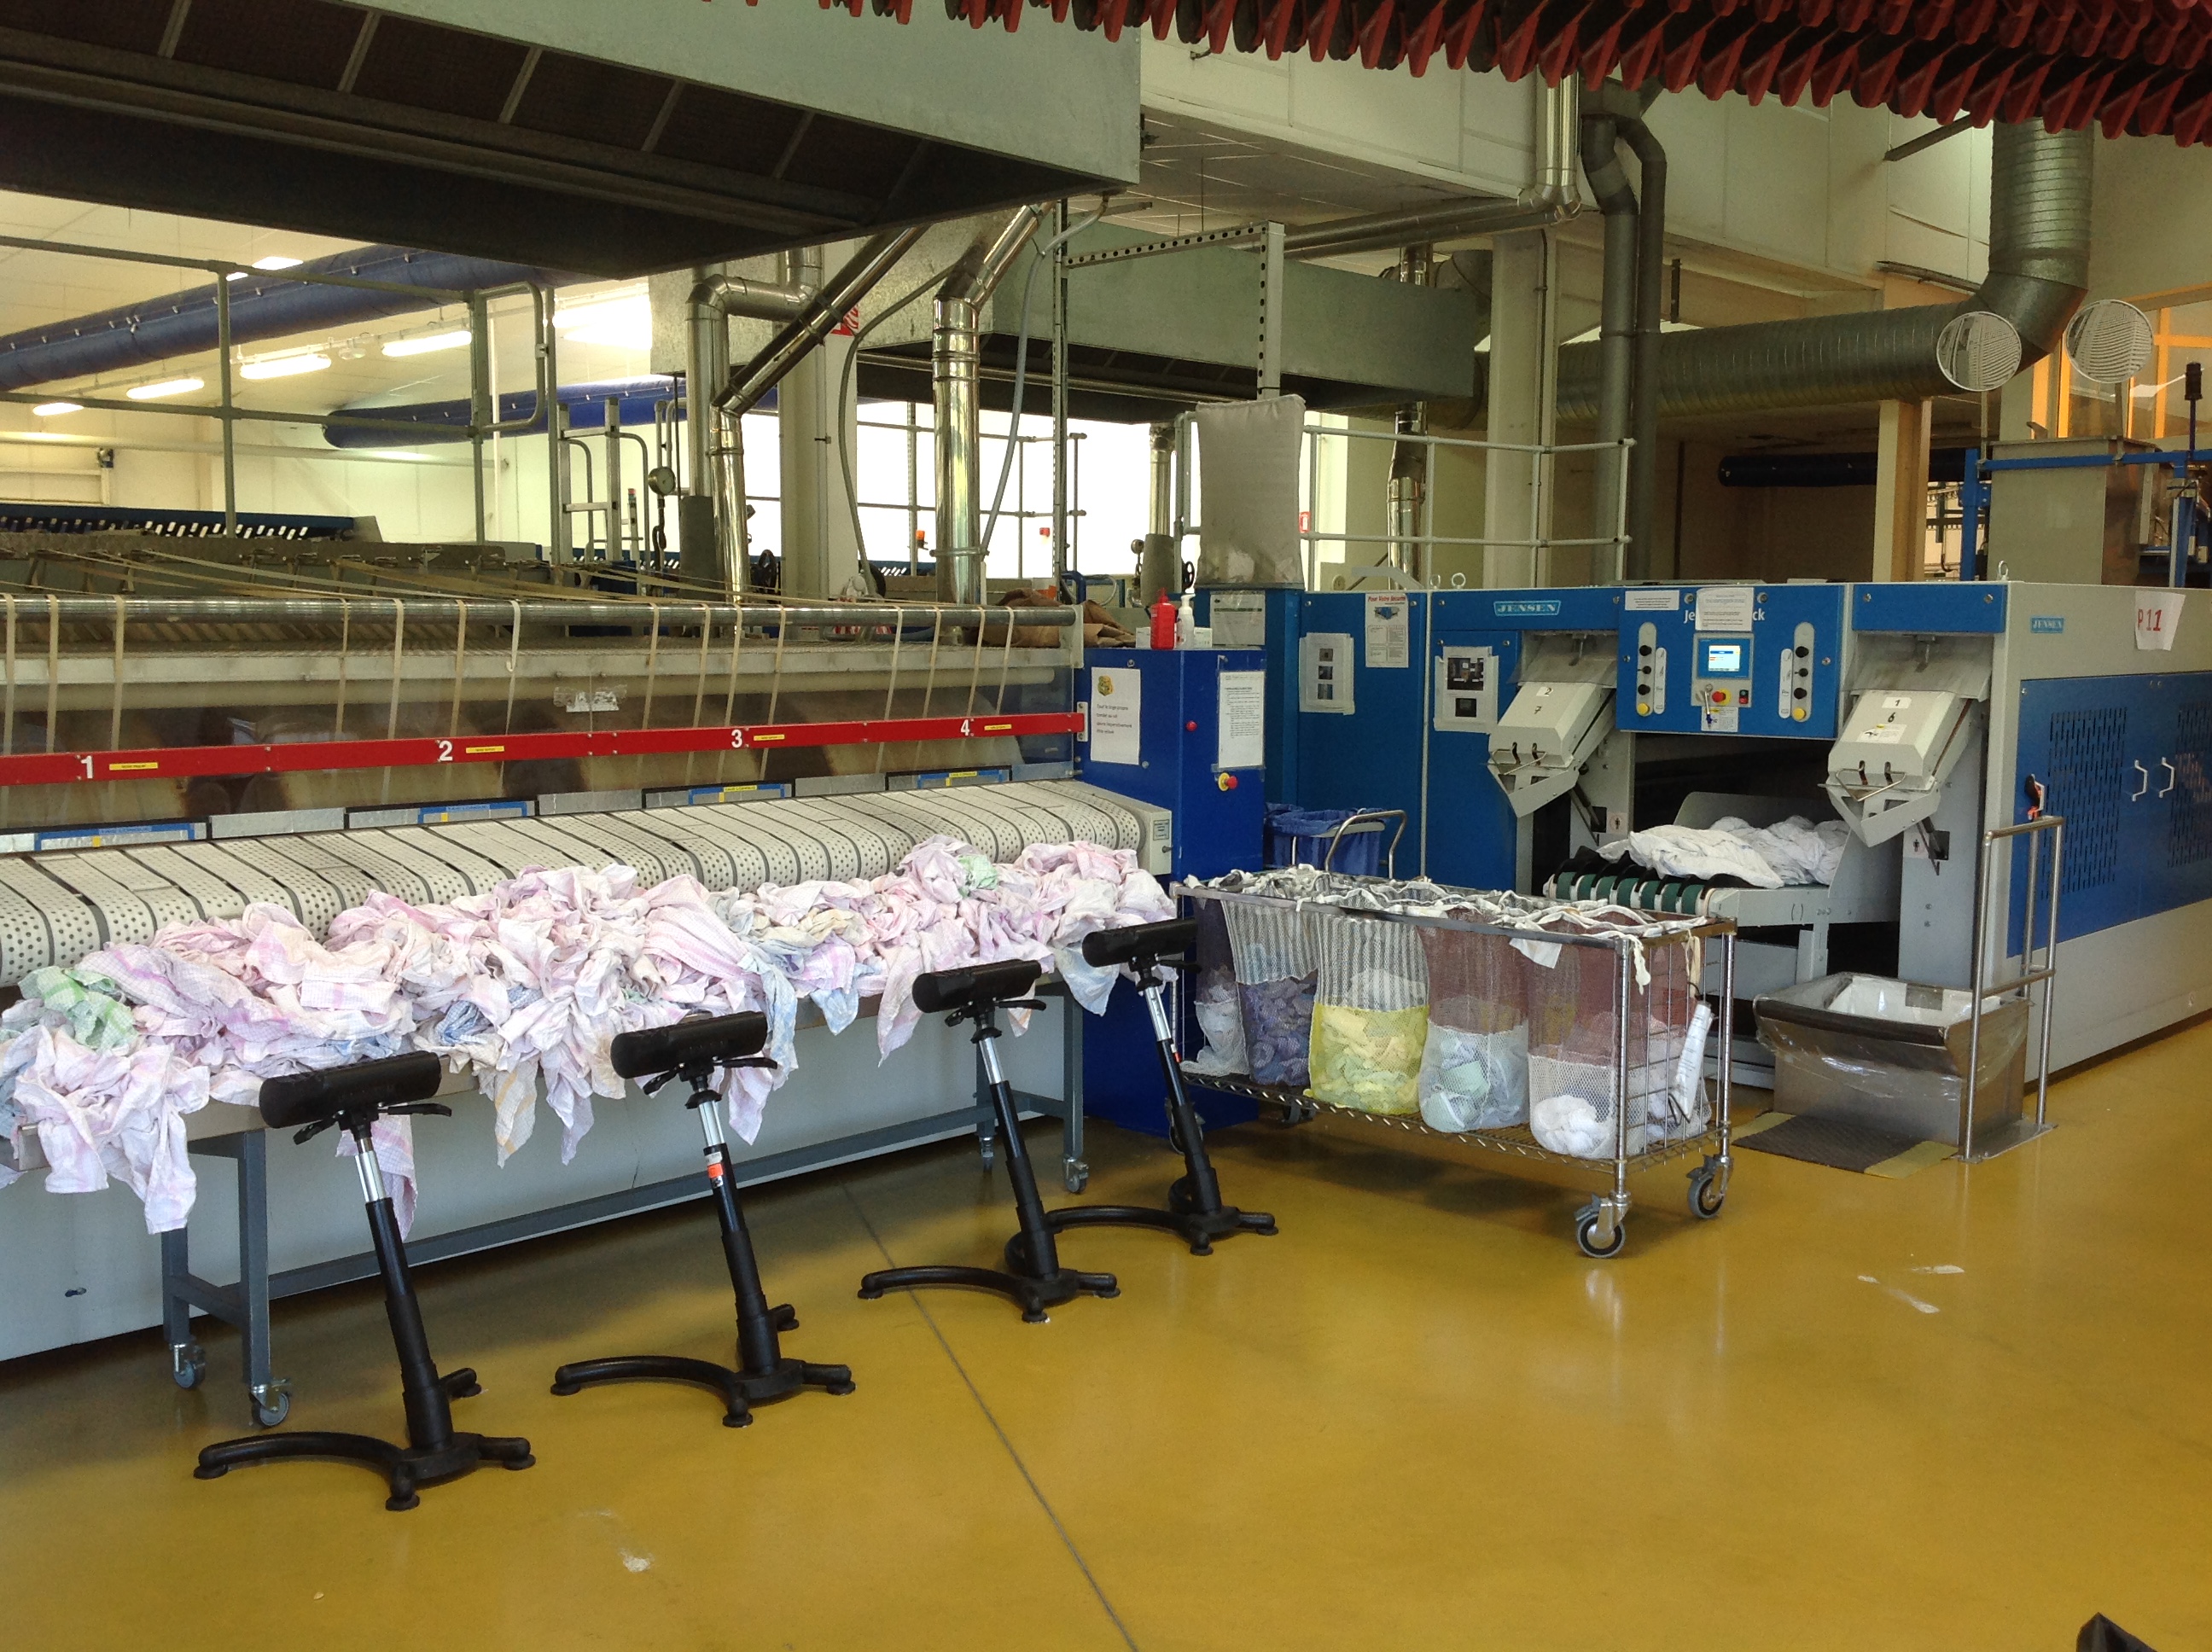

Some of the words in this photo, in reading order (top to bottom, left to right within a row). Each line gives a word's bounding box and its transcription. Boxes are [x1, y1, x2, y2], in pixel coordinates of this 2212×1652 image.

[1498, 603, 1556, 614] JENSEN
[1544, 687, 1553, 695] 2
[1888, 712, 1896, 723] 6
[960, 718, 970, 736] 4
[731, 729, 742, 748] 3
[439, 740, 453, 761] 2
[80, 754, 93, 779] 1
